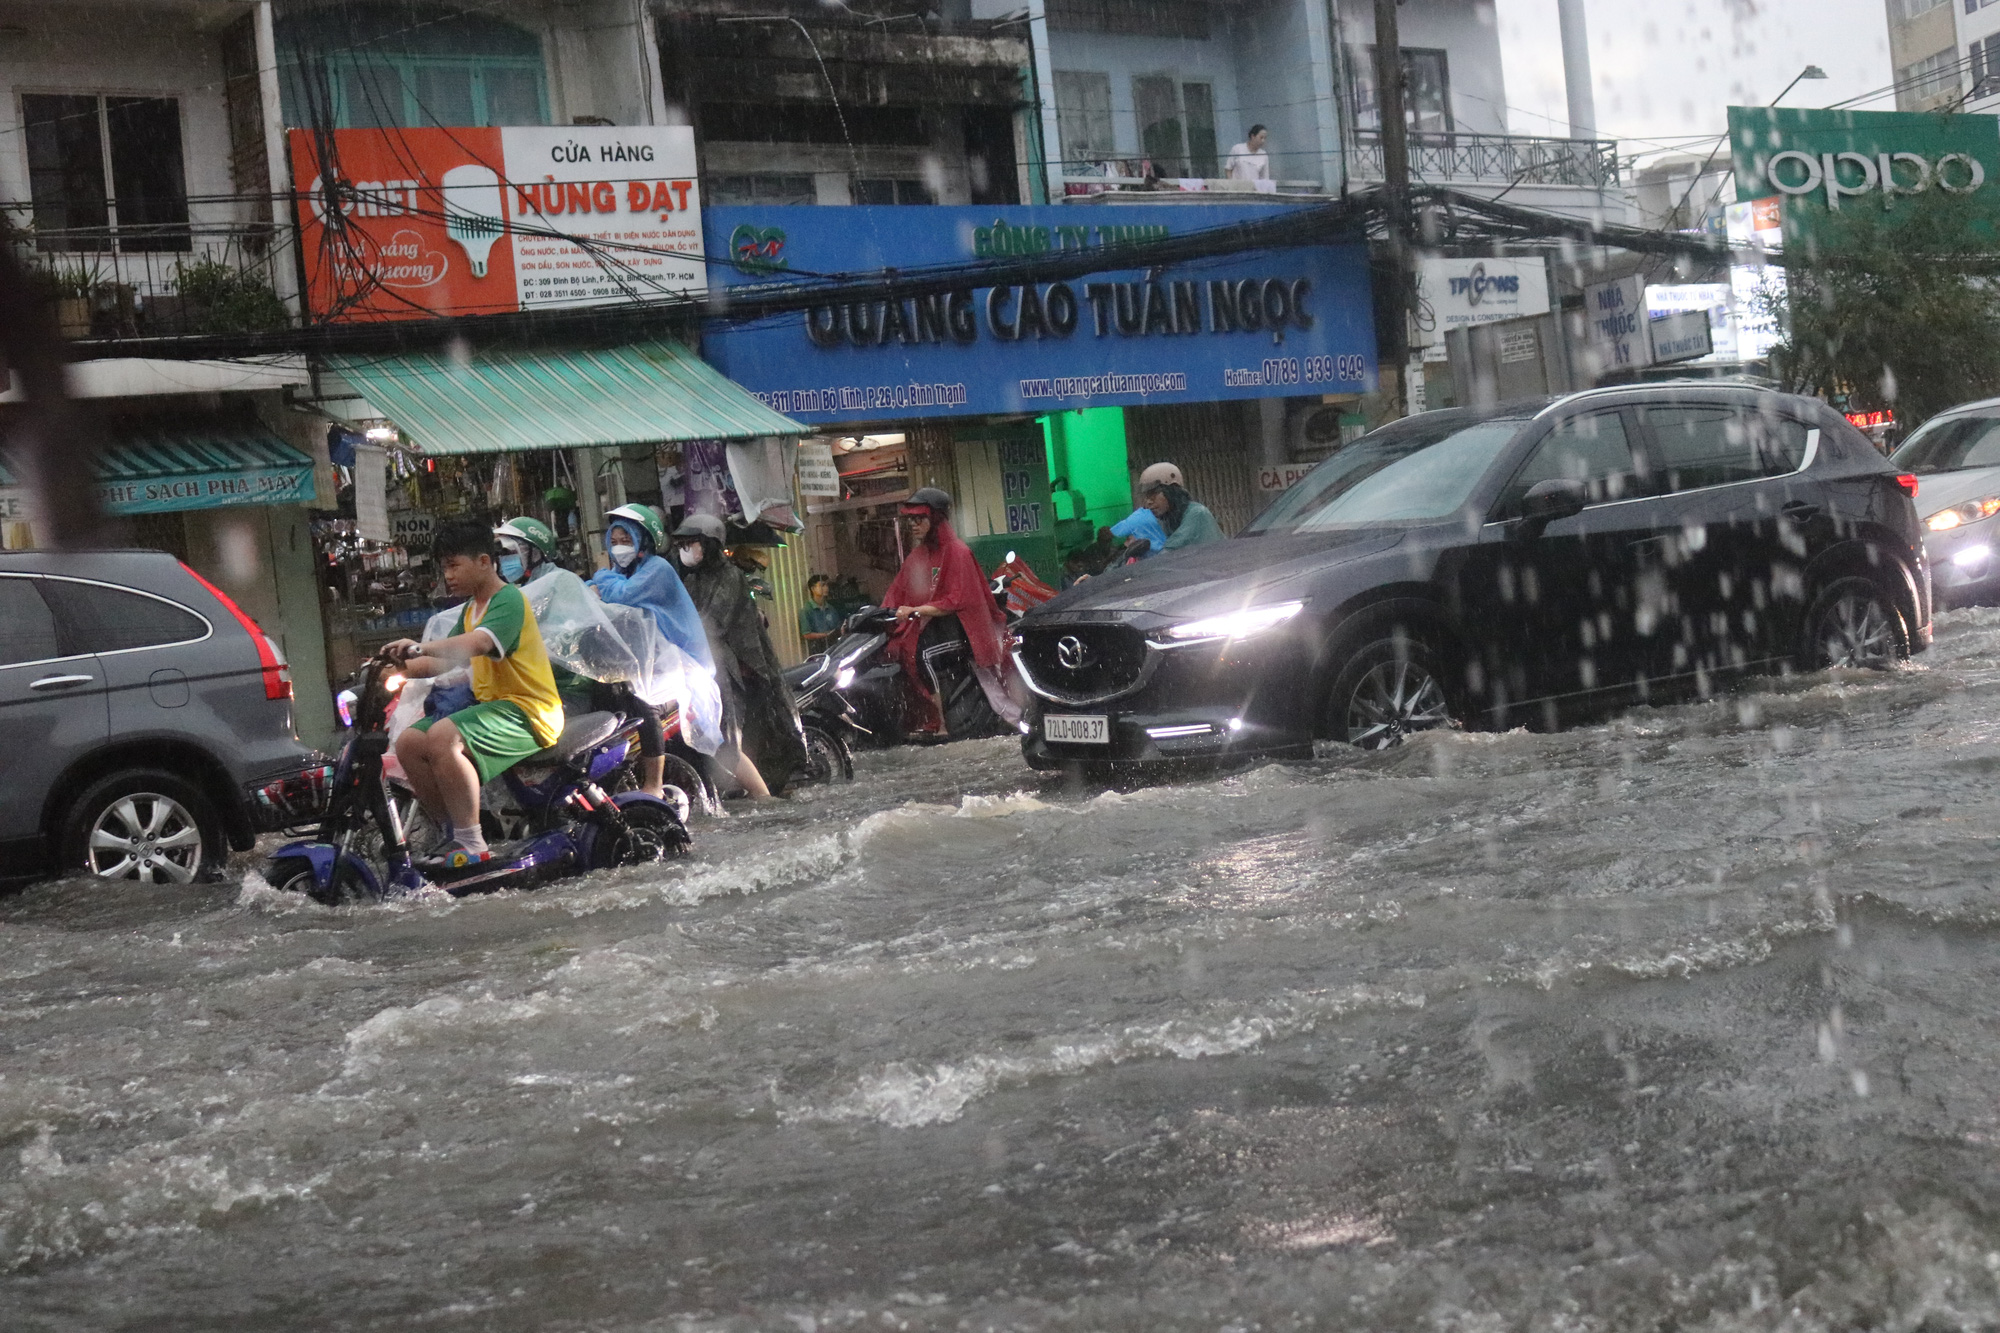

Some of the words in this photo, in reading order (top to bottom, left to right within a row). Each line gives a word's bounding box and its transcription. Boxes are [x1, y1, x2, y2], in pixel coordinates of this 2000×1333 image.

[551, 140, 591, 163] CỬA
[601, 141, 654, 162] HÀNG
[516, 174, 617, 216] HÙNG
[627, 180, 692, 222] ĐẠT
[679, 272, 695, 281] HCM
[1206, 278, 1314, 345] NGỌC
[1225, 368, 1262, 387] Hotline:
[1262, 357, 1299, 386] 0789
[1304, 355, 1334, 384] 939
[1338, 353, 1365, 381] 949
[821, 387, 838, 414] Bộ
[935, 383, 967, 408] Thạnh
[145, 480, 200, 503] SẠCH
[206, 478, 250, 495] PHA
[1004, 470, 1031, 499] PP
[396, 516, 430, 532] NÓN
[1007, 502, 1042, 538] BẠT
[527, 526, 549, 544] Grab
[1047, 718, 1104, 739] 72LD-008.37
